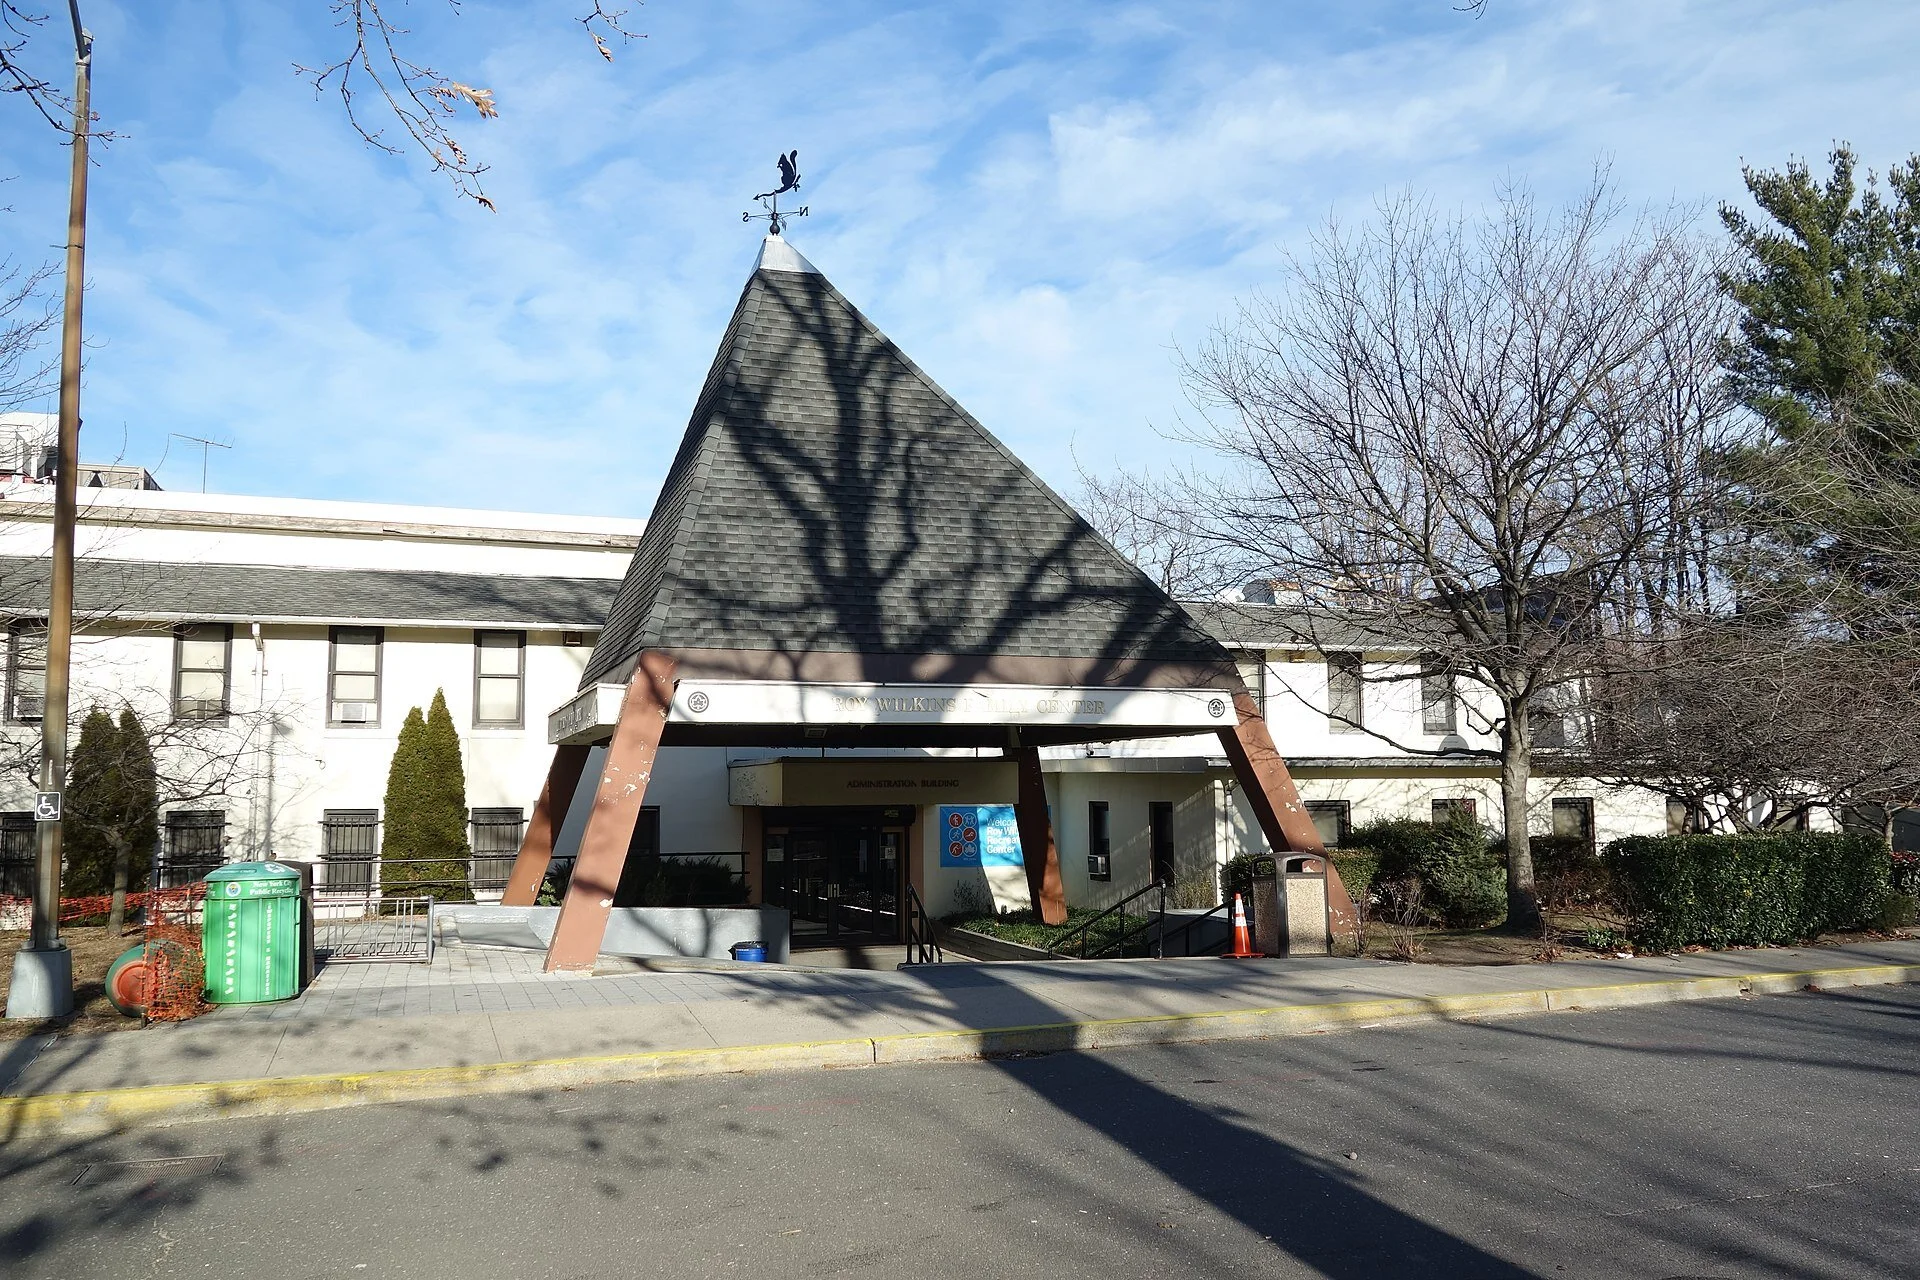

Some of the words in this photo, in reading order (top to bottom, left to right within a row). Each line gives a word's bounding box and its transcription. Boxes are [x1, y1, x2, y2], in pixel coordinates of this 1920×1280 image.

[831, 696, 868, 712] ROY
[875, 697, 957, 713] WILKINS
[1036, 699, 1106, 714] CENTER
[846, 779, 917, 789] ADMINISTRATION
[920, 779, 960, 788] BUILDING
[986, 826, 1003, 837] Roy
[986, 844, 1016, 854] Center
